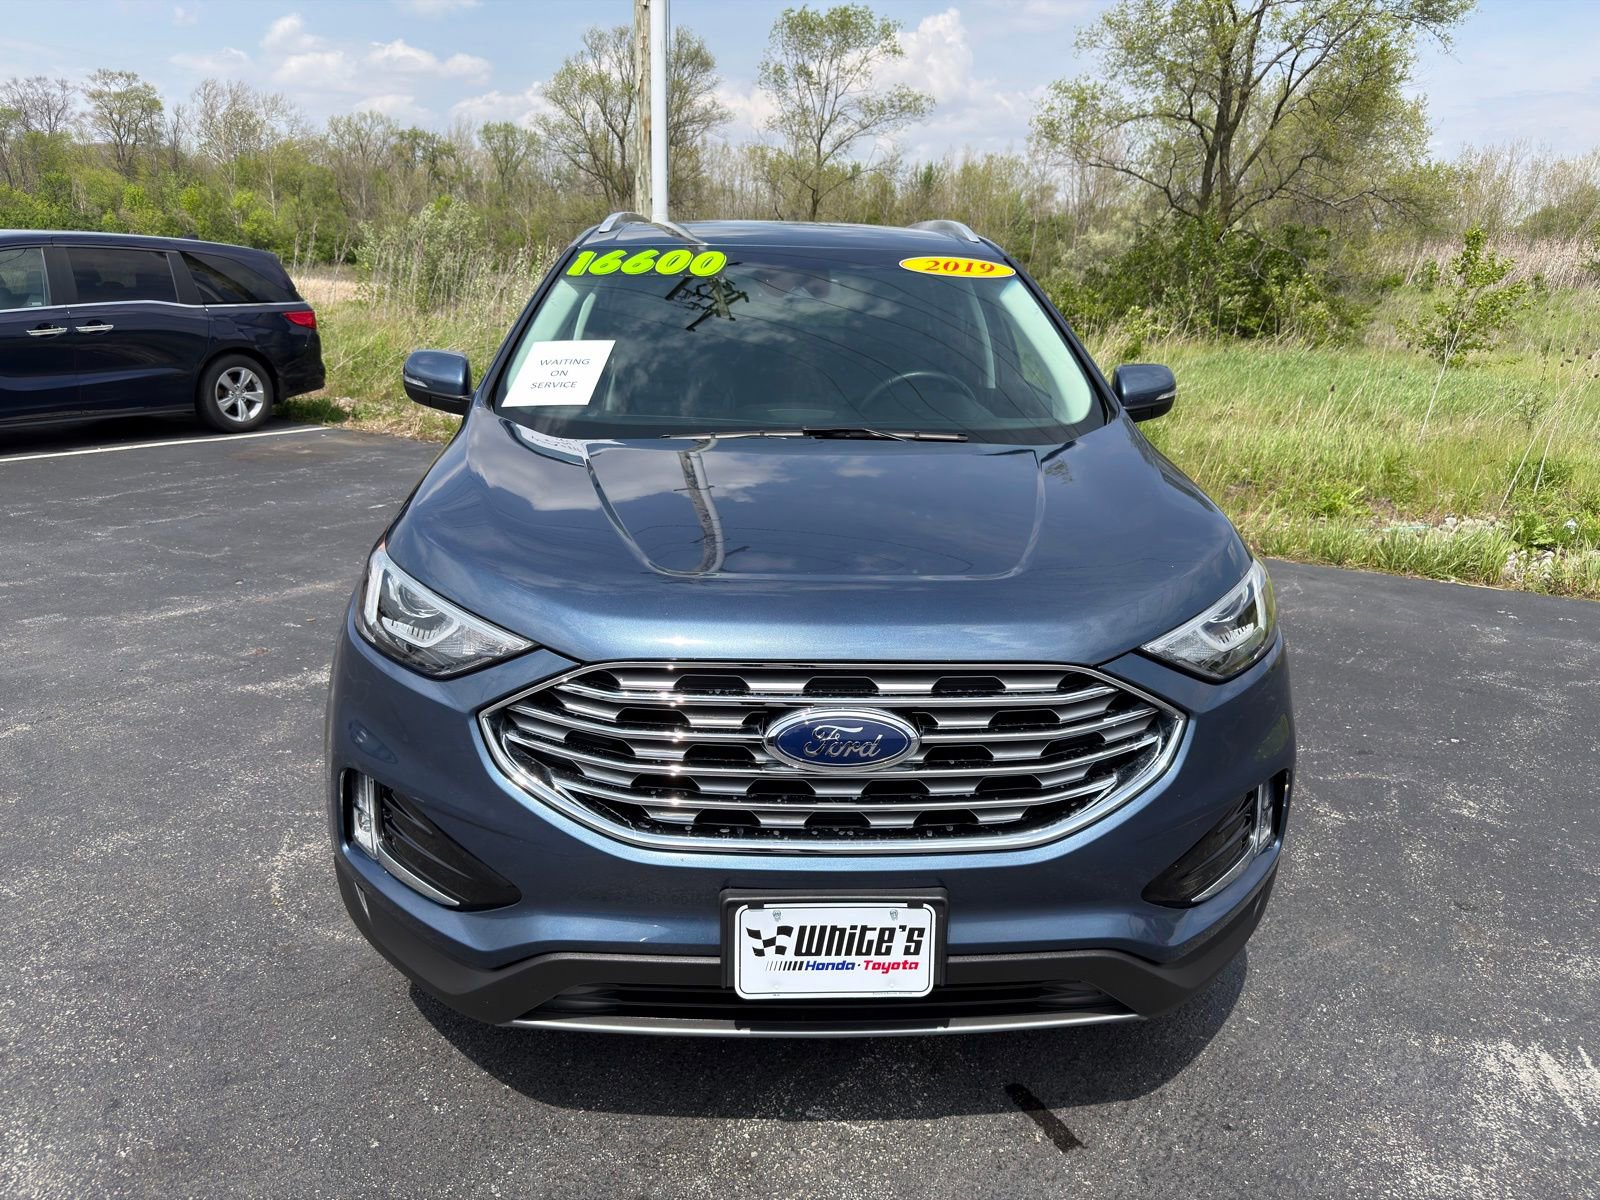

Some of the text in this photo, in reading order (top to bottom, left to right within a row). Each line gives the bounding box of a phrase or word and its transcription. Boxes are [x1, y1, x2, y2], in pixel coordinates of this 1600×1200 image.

[566, 249, 728, 277] 16600
[925, 260, 995, 273] 2019
[540, 358, 591, 366] WAITING
[530, 381, 577, 389] SERVICE
[803, 725, 883, 758] Ford
[794, 925, 926, 957] White's
[805, 960, 919, 974] Honda Toyota
